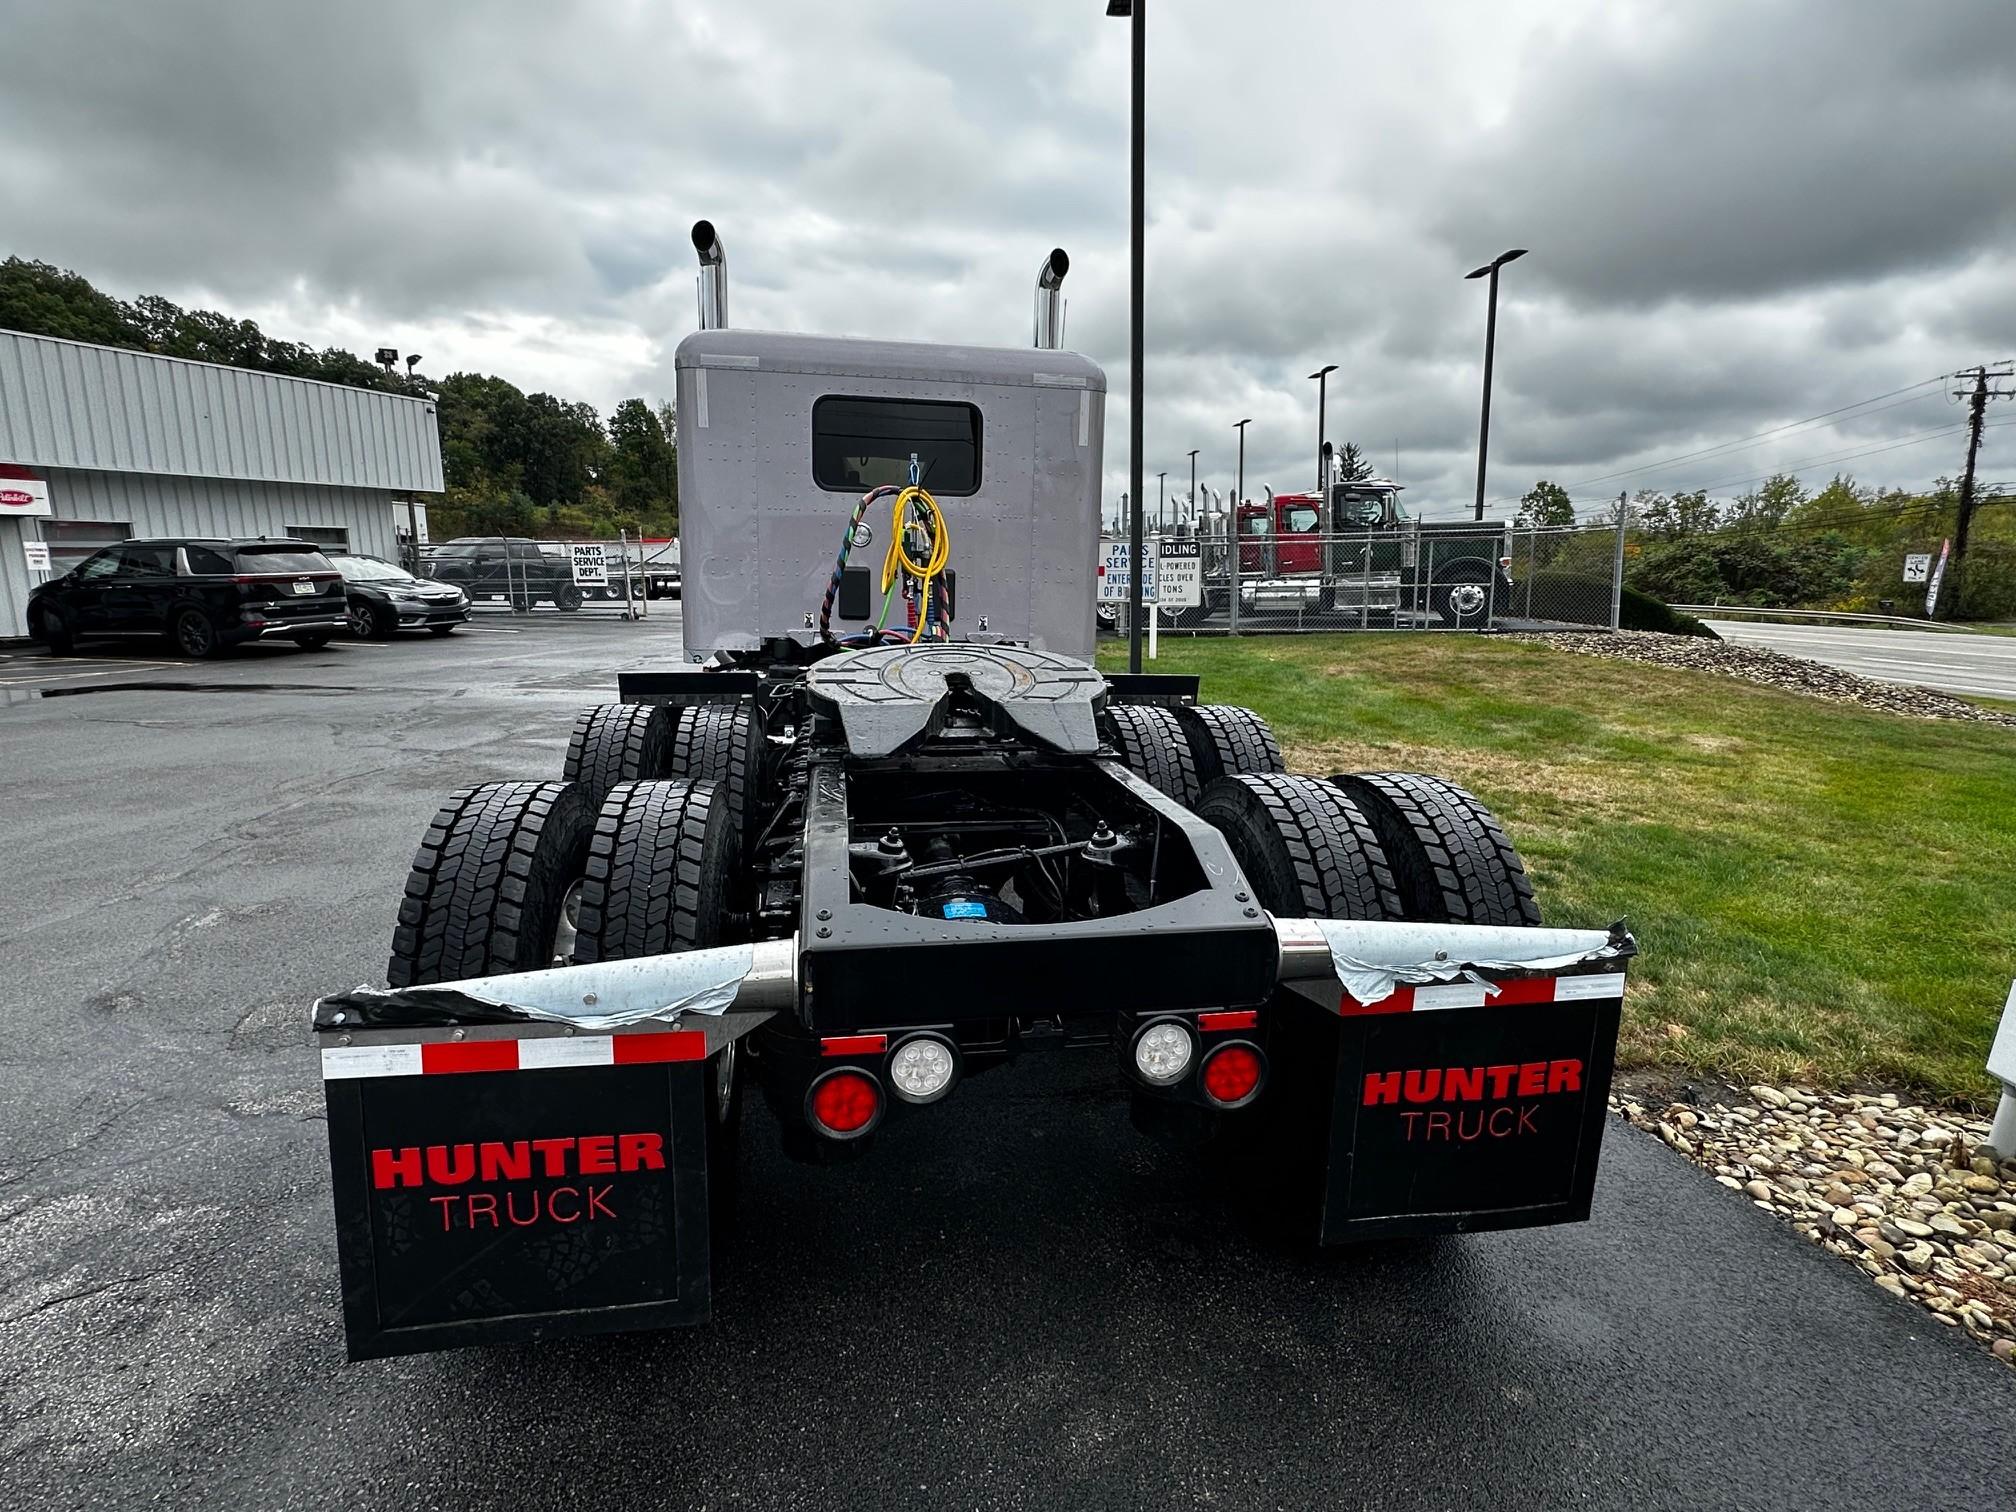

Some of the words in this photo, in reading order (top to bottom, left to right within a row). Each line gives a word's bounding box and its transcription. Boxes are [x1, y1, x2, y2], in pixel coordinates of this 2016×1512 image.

[574, 546, 602, 556] PARTS
[1112, 544, 1150, 556] PAS
[1161, 544, 1197, 555] IDLING
[573, 557, 605, 566] SERVICE
[1106, 557, 1155, 569] SERCE
[579, 567, 602, 577] DEPT.
[1177, 573, 1194, 581] OVER
[1104, 586, 1114, 597] OF
[1163, 585, 1183, 593] TONS
[1363, 1058, 1583, 1106] HUNTER
[1400, 1104, 1540, 1141] TRUCK
[372, 1132, 666, 1189] HUNTER
[430, 1184, 617, 1232] TRUCK
